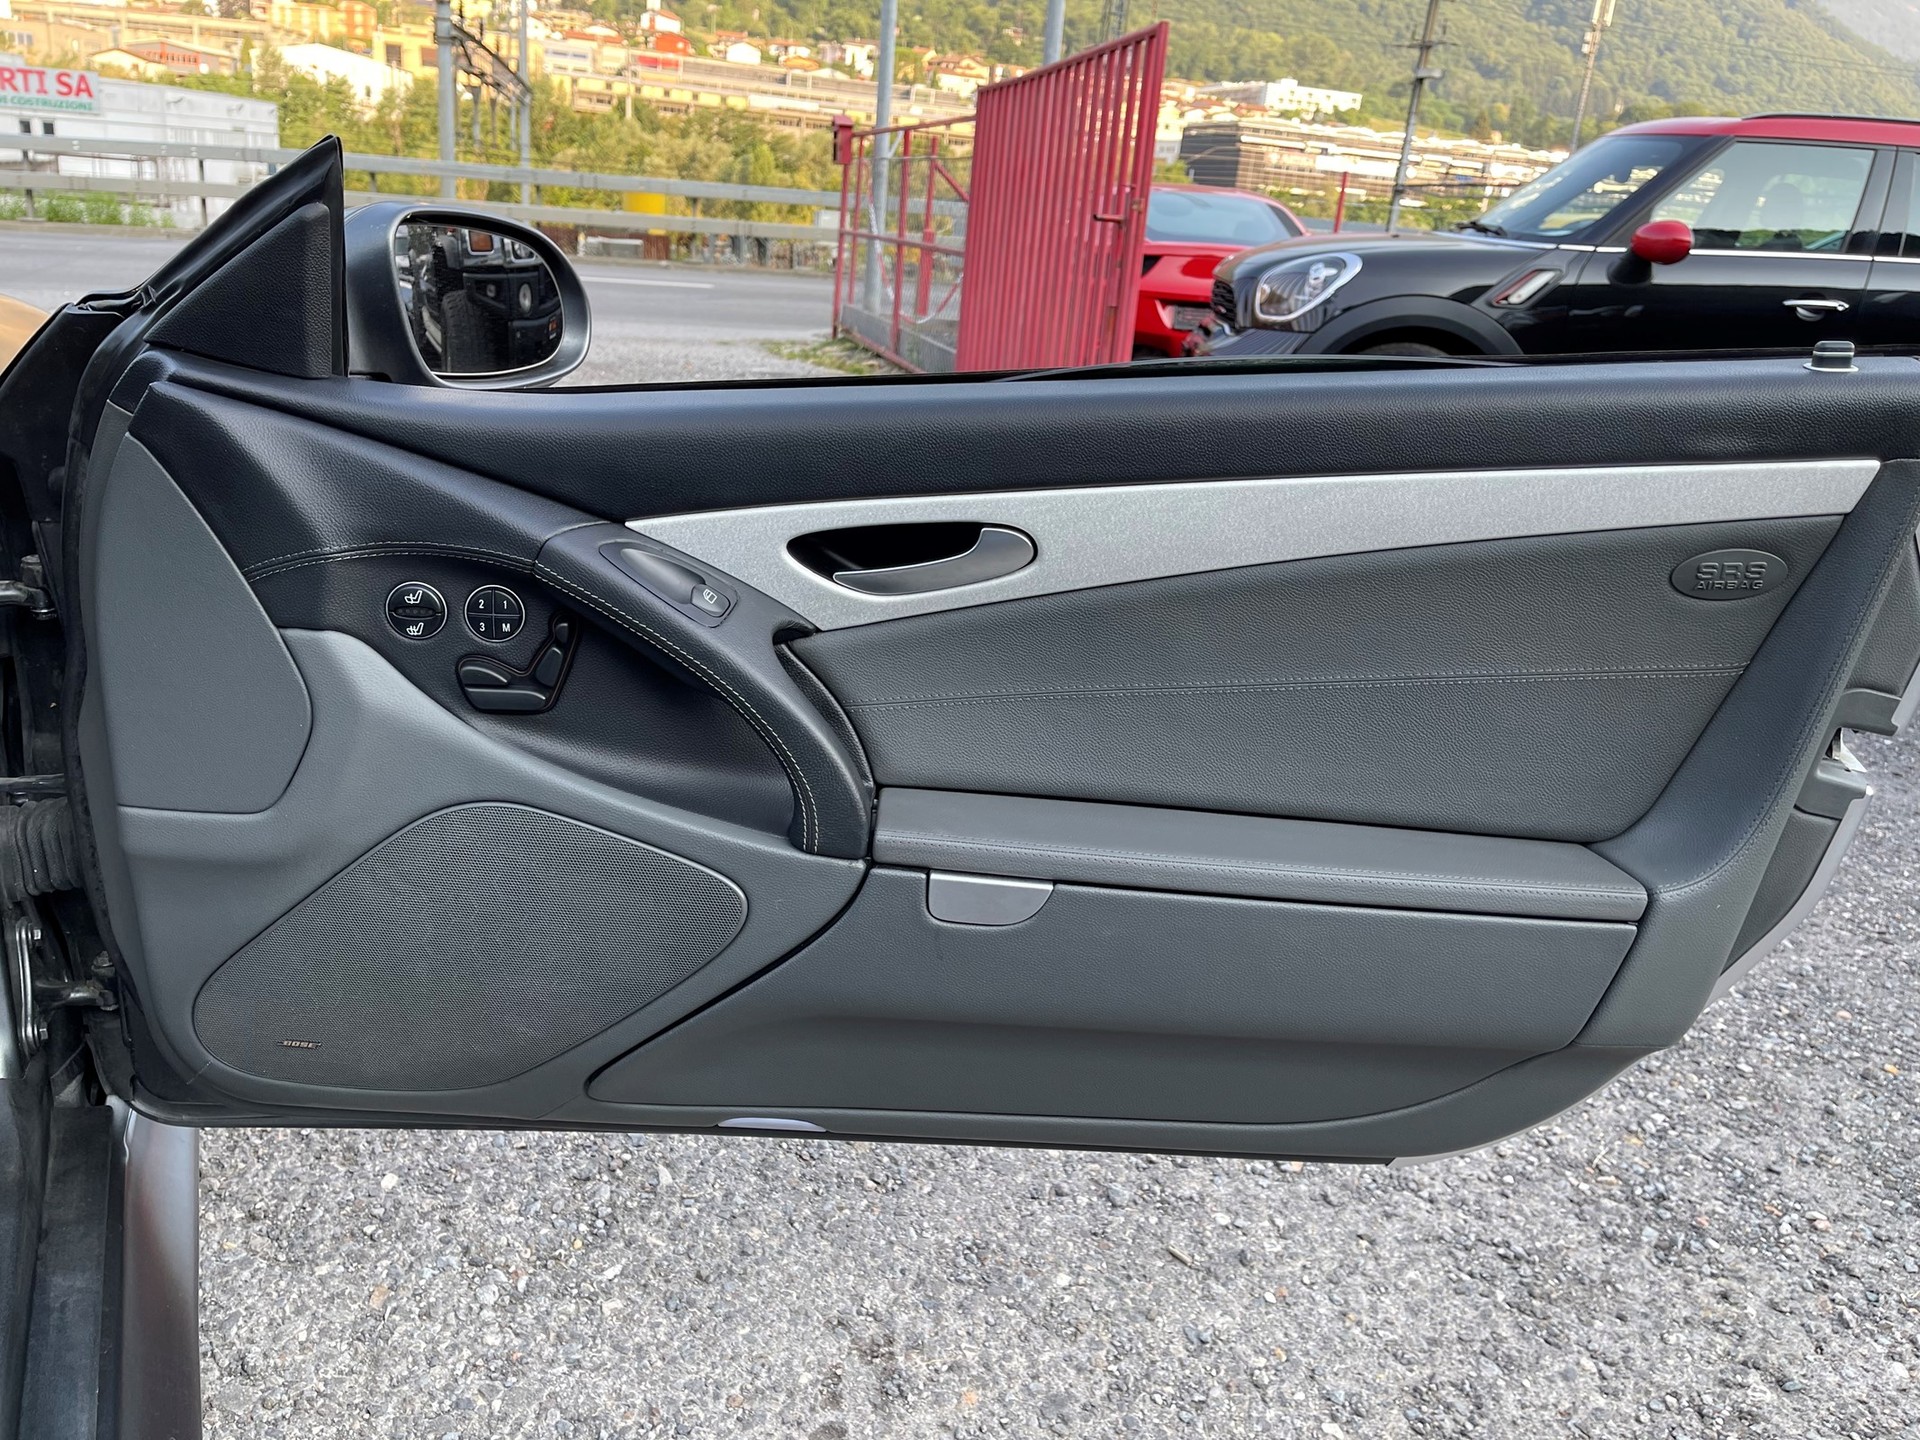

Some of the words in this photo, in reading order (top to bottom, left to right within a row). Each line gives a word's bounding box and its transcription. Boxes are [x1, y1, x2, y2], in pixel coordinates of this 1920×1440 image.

[55, 71, 93, 98] SA
[1695, 561, 1768, 580] SRS
[1694, 580, 1765, 591] AIRBAG
[478, 599, 485, 609] 2
[479, 622, 486, 632] 3
[502, 623, 511, 633] M
